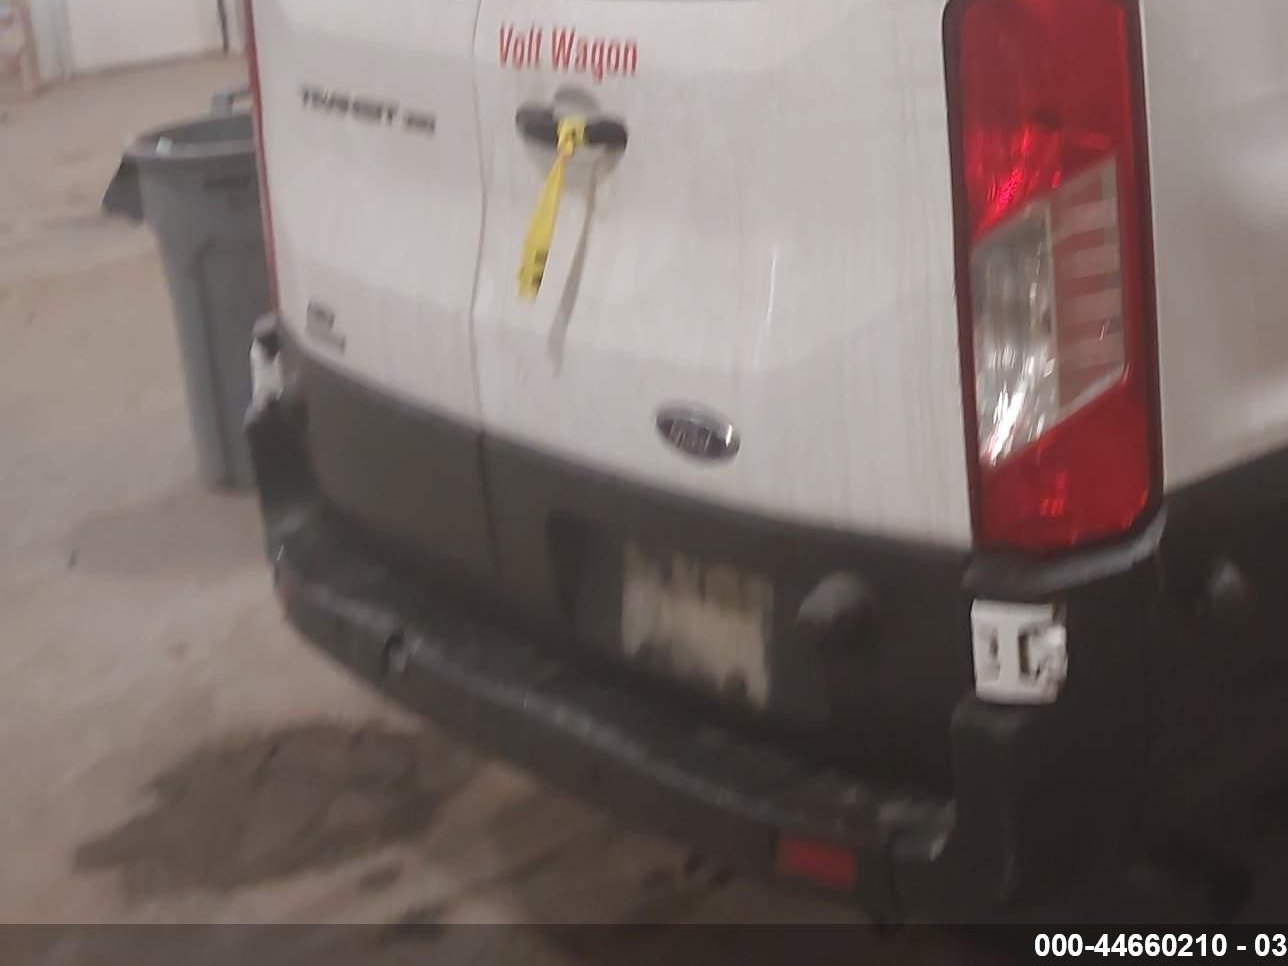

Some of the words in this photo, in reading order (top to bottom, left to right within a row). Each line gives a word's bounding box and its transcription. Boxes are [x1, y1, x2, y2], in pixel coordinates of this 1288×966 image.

[499, 23, 543, 68] Volt
[551, 26, 637, 82] Wagon
[301, 85, 399, 125] TRAT
